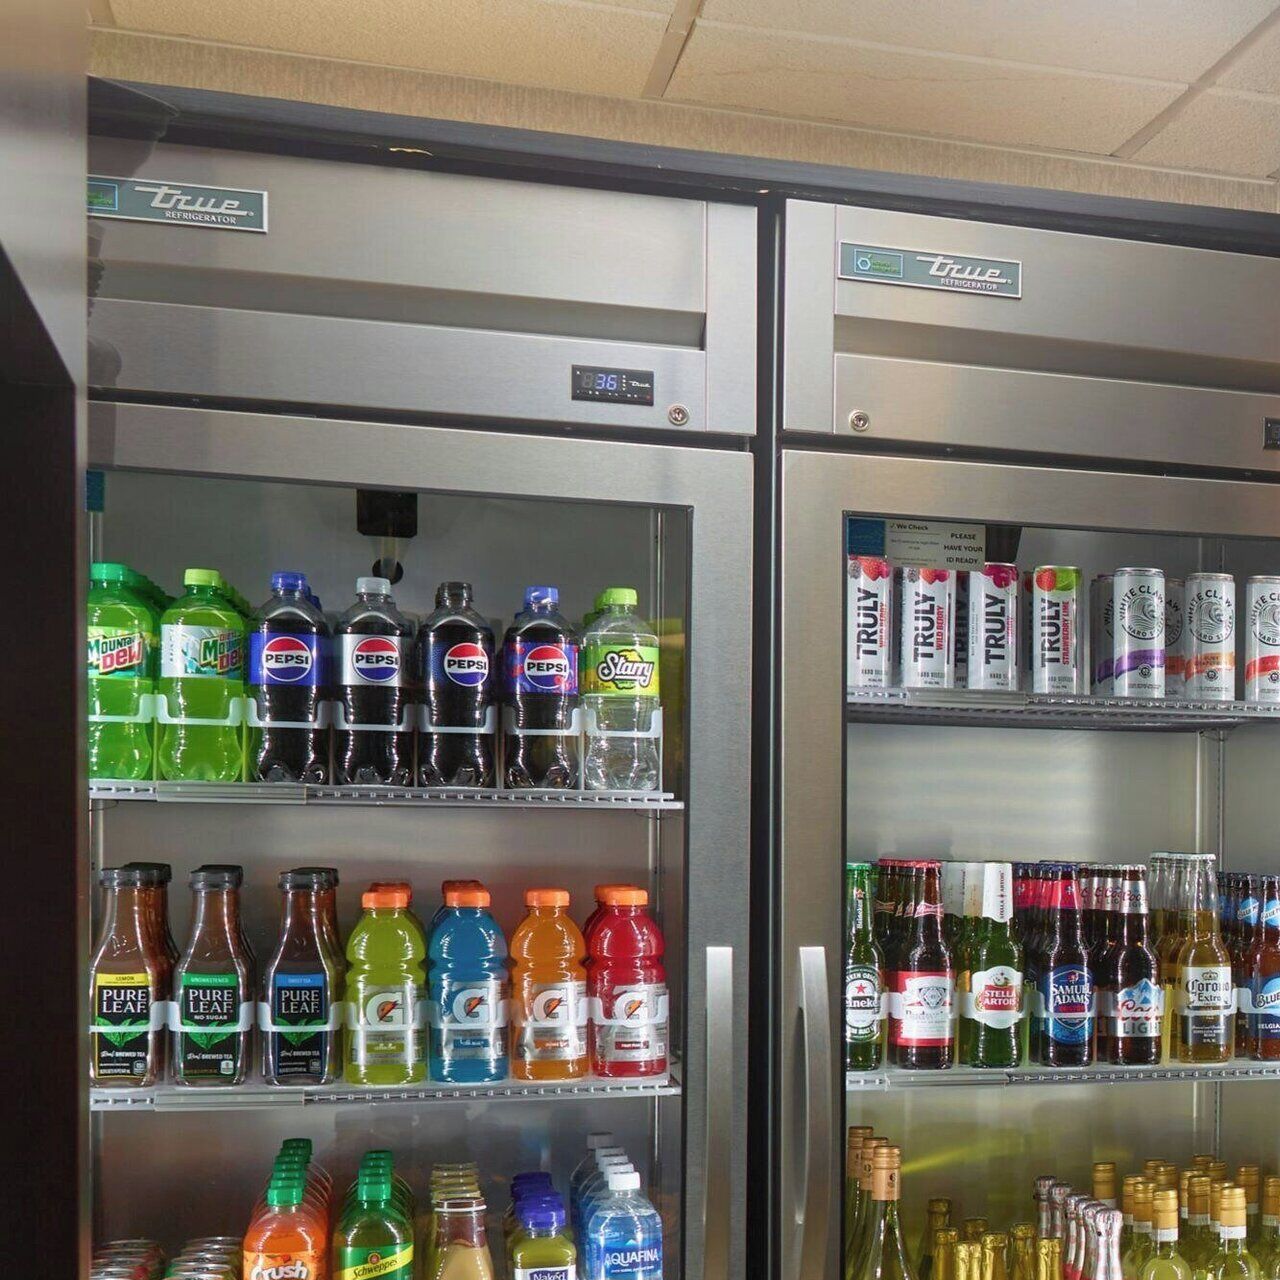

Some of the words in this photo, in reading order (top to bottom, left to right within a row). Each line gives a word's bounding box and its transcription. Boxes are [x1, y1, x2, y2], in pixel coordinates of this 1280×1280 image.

[165, 211, 236, 224] REFRIGERATOR
[941, 280, 997, 291] REFRIGERATOR
[596, 374, 617, 390] 36
[857, 587, 878, 659] TRULY
[913, 592, 935, 662] TRULY
[985, 594, 1006, 664] TRULY
[1041, 598, 1060, 668] TRULY
[265, 654, 309, 665] PEPSI
[355, 654, 399, 666] PEPSI
[447, 658, 488, 670] PEPSI
[527, 662, 567, 672] PEPSI
[598, 651, 654, 686] Starry
[102, 989, 147, 1001] PURE
[189, 990, 233, 1001] PURE
[281, 990, 319, 1001] PURE
[984, 990, 1016, 998] STELLA
[1051, 983, 1092, 996] SAMUEL
[982, 998, 1016, 1006] ARTOIS
[1053, 993, 1090, 1004] ADAMS
[1257, 993, 1280, 1008] BLUE
[604, 1249, 659, 1266] AQUAFINA
[352, 1256, 400, 1279] Schweppes
